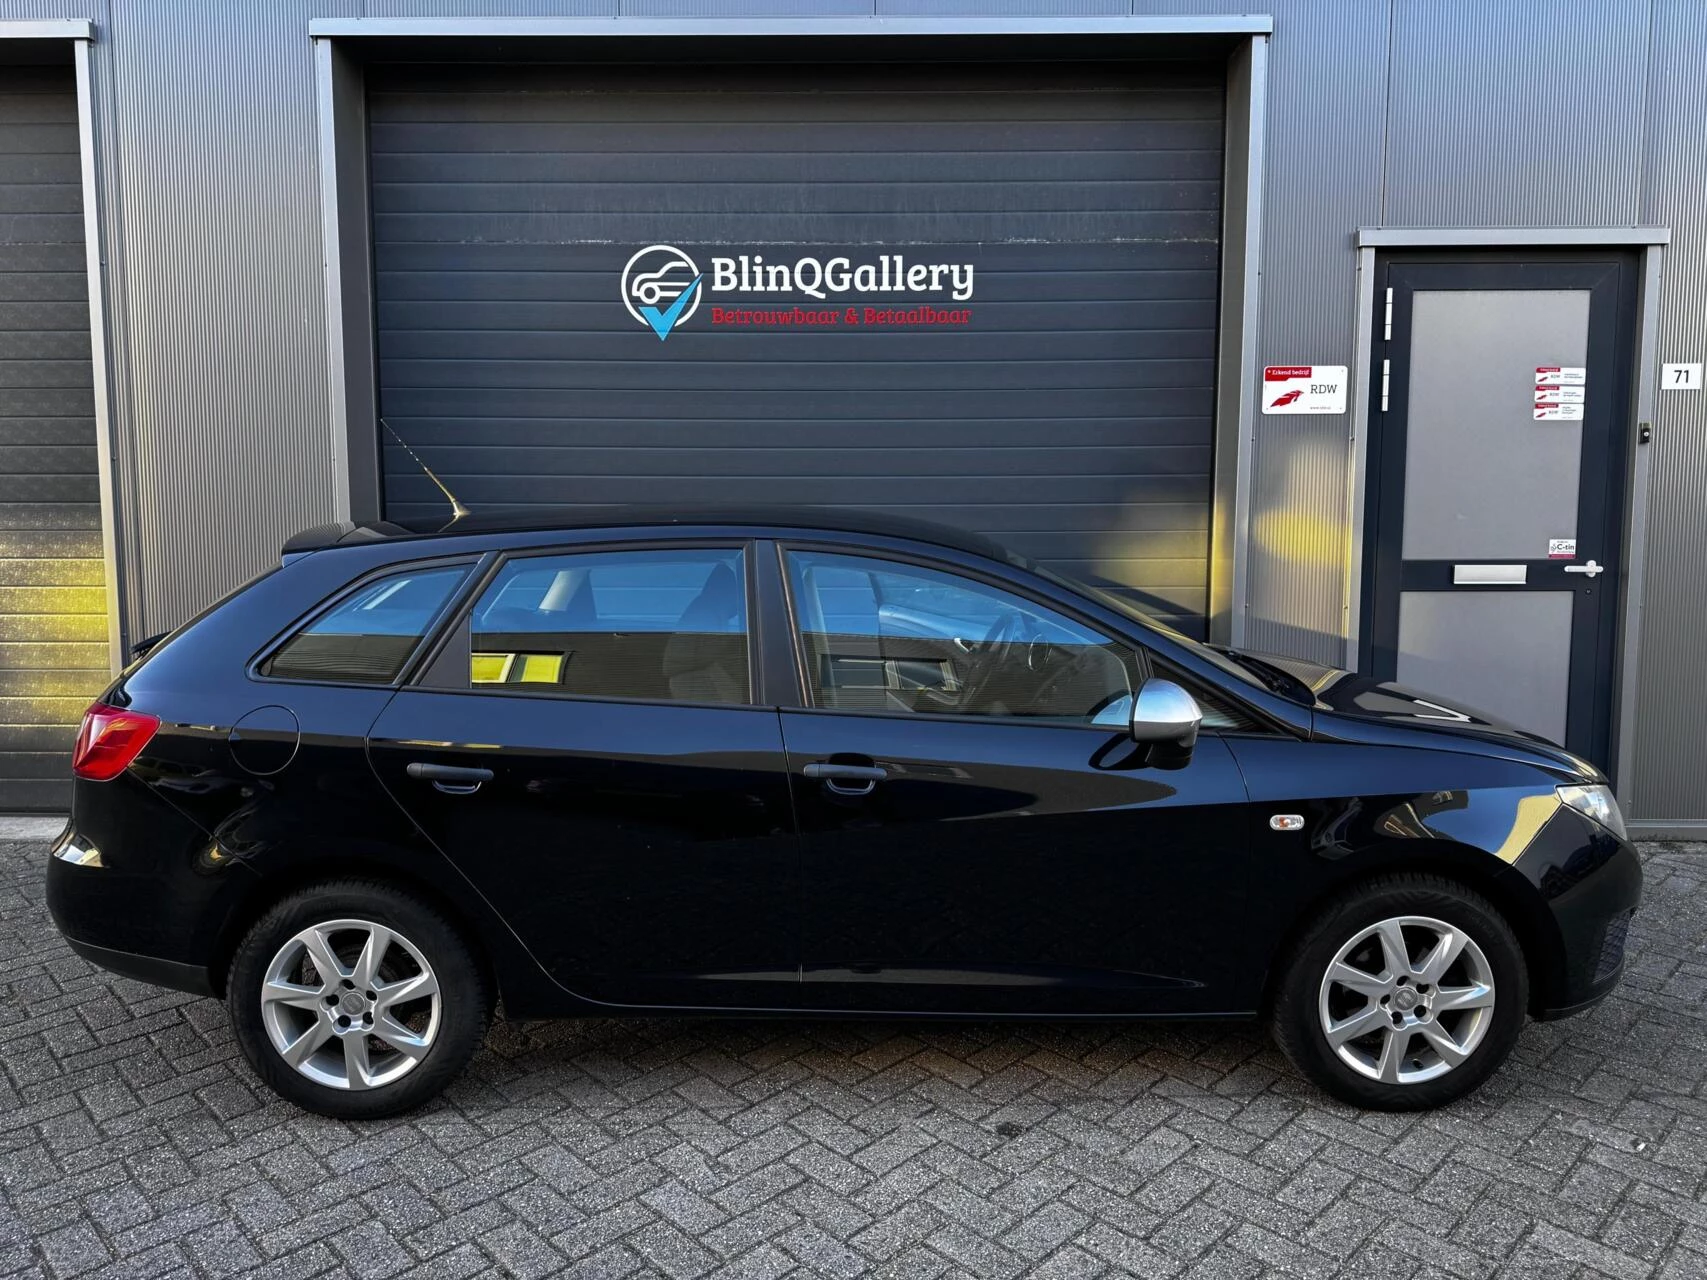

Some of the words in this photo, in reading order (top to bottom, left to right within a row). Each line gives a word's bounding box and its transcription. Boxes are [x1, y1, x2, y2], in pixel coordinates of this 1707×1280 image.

[711, 255, 974, 300] BlinQGallery
[711, 307, 839, 325] Betrouwbaar
[845, 308, 859, 325] &
[864, 307, 972, 325] Betaalbaar
[1674, 370, 1689, 384] 71
[1310, 384, 1338, 394] RDW
